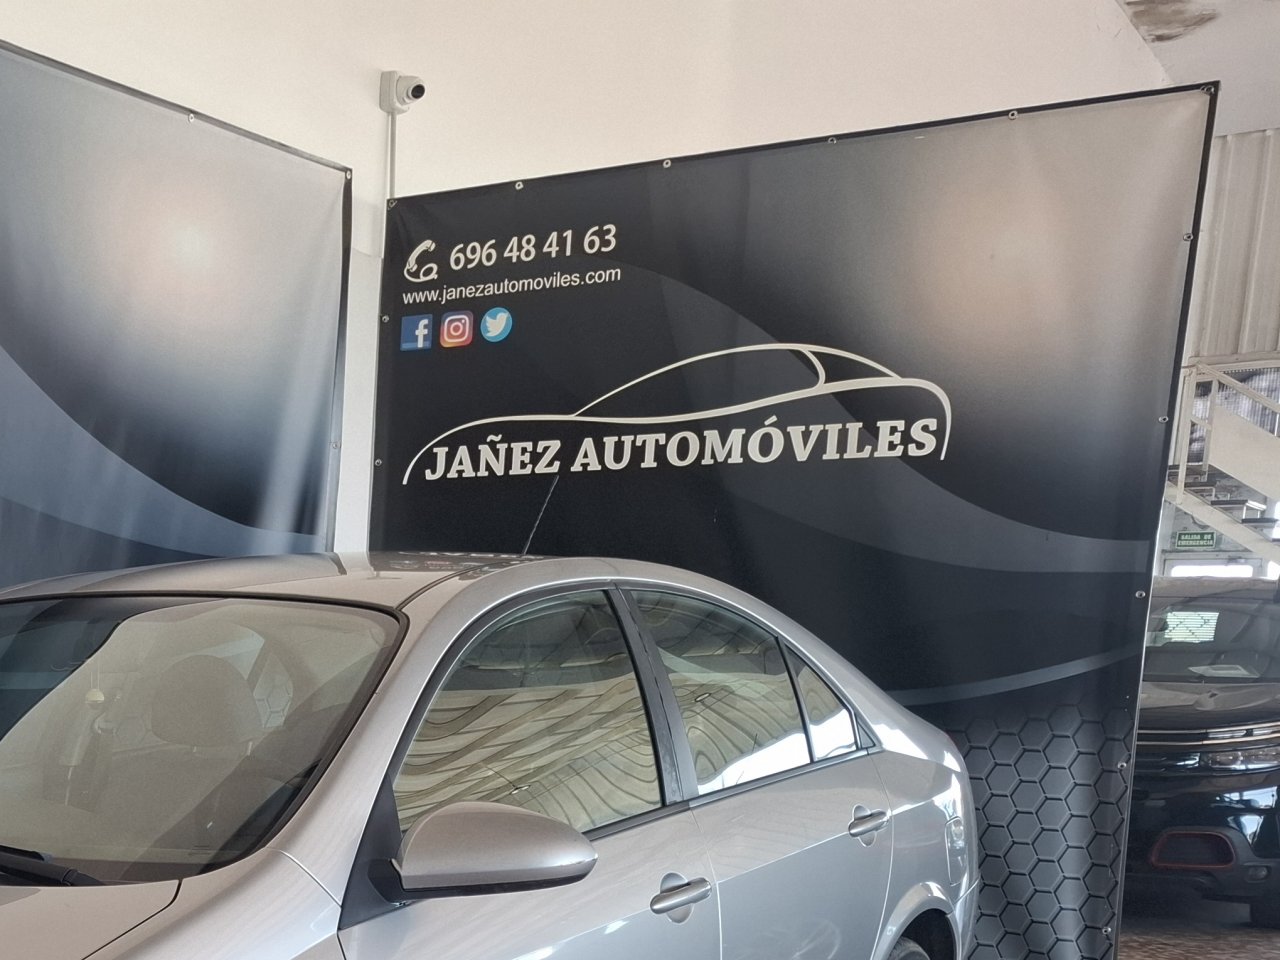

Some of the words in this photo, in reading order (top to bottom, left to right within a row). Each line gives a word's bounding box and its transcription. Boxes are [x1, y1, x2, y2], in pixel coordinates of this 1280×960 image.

[449, 238, 497, 271] 696
[503, 233, 536, 263] 48
[542, 229, 573, 258] 41
[583, 223, 617, 254] 63
[402, 267, 621, 304] www.janezautomoviles.com
[424, 434, 562, 481] JAÑEZ
[570, 414, 938, 472] AUTOMÓVILES
